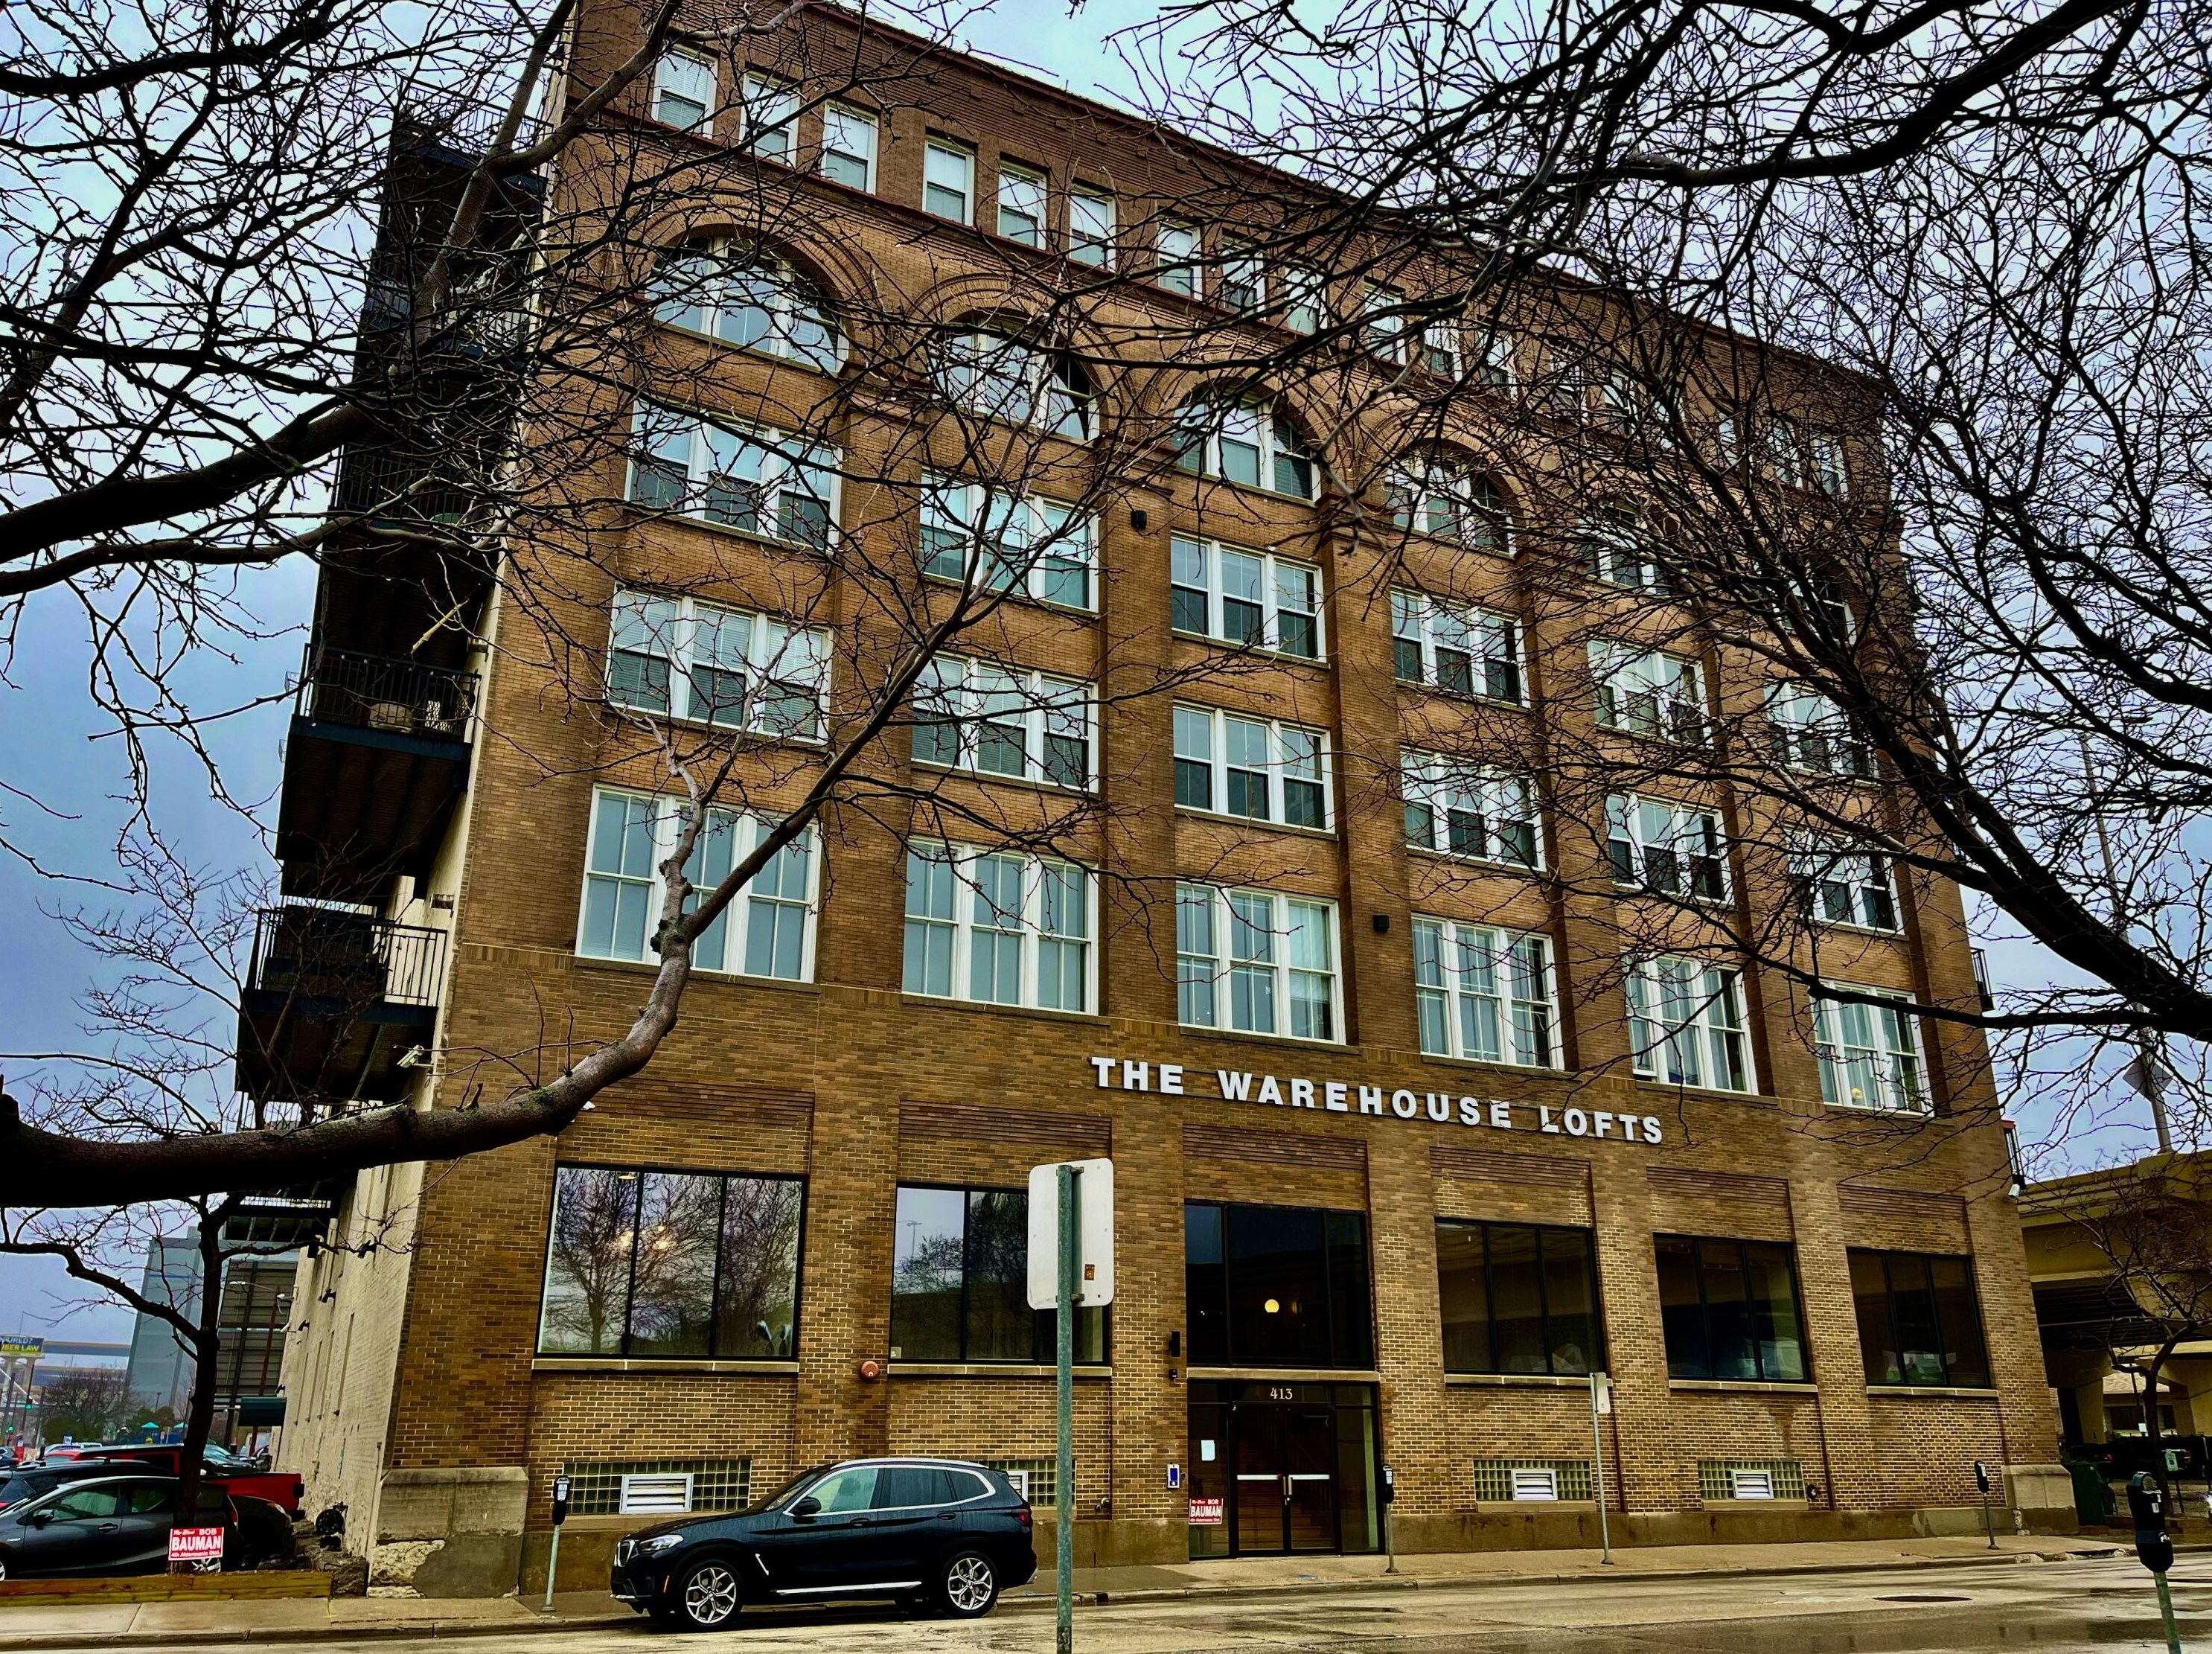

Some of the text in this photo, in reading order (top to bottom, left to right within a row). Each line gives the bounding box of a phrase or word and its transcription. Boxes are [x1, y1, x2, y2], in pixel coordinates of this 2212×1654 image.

[1091, 1056, 1663, 1144] THE WAREHOUSE LOFTS
[1270, 1387, 1293, 1399] 413
[1191, 1505, 1221, 1517] BAUMAN
[172, 1536, 221, 1551] BAUMAN
